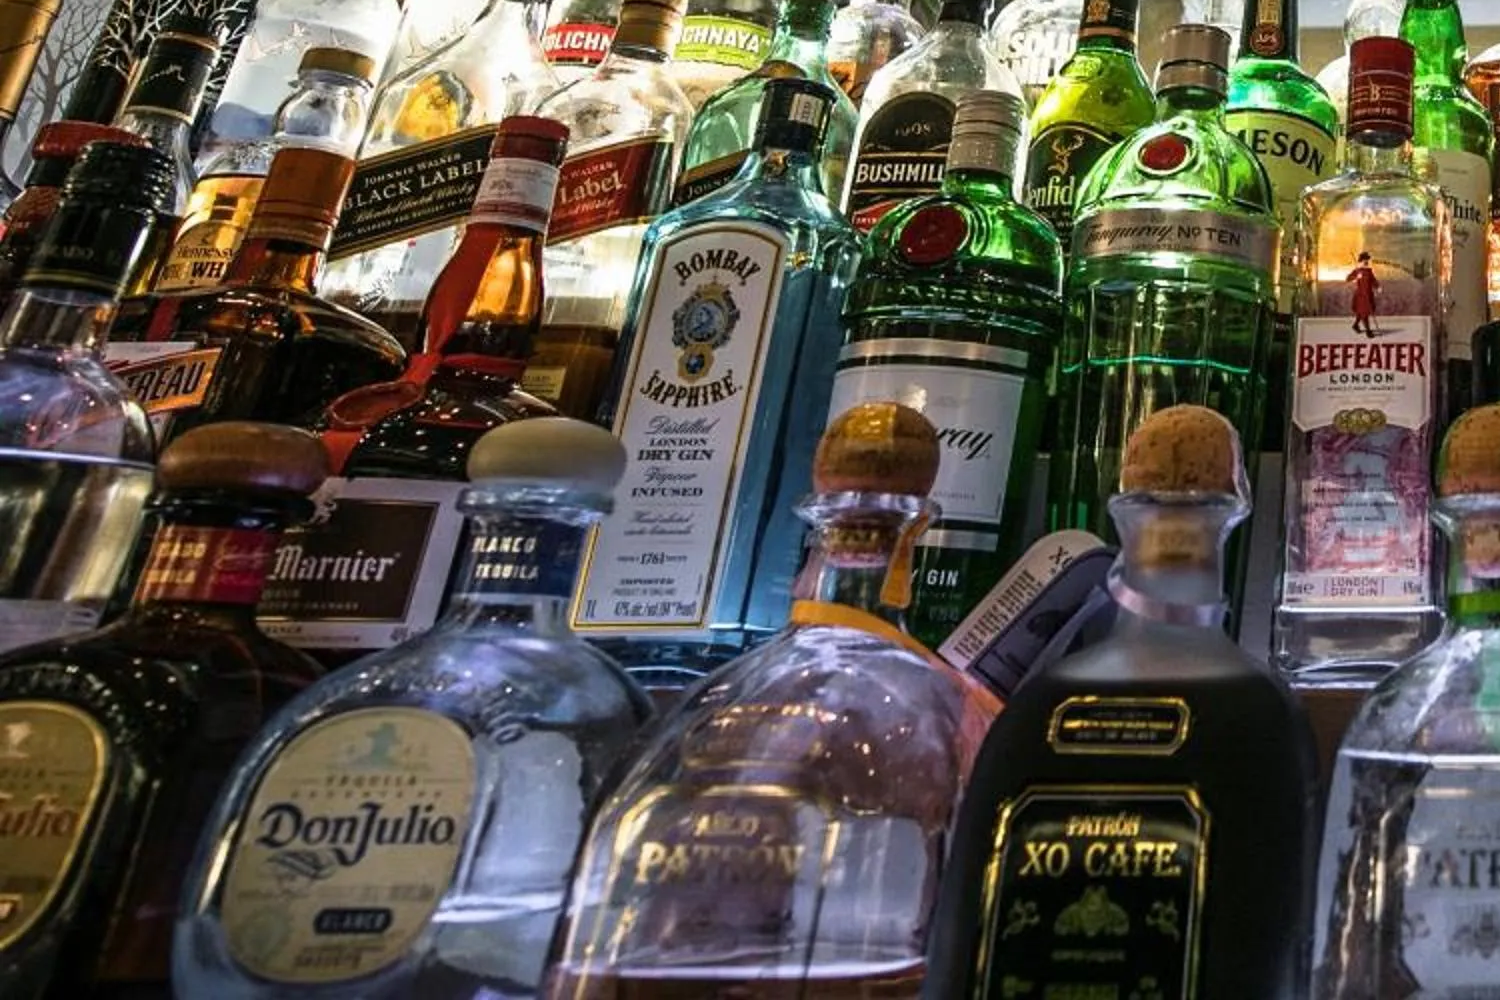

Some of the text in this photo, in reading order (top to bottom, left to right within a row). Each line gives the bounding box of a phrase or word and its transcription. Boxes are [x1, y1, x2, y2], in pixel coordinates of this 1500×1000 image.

[420, 159, 486, 190] LABEL
[560, 170, 623, 204] Label
[1205, 228, 1241, 246] TEN
[673, 248, 761, 281] BOMBAY
[1298, 342, 1426, 379] BEEFEATER
[1329, 373, 1395, 385] LONDON
[640, 374, 738, 408] SAPPHIRE
[645, 415, 721, 436] Distilled
[650, 437, 708, 447] LONDON
[637, 450, 714, 461] DRY GIN
[631, 487, 704, 498] INFUSED
[266, 544, 393, 582] Marnier
[927, 568, 959, 587] GIN
[1331, 577, 1379, 588] LONDON
[1019, 841, 1071, 877] XO
